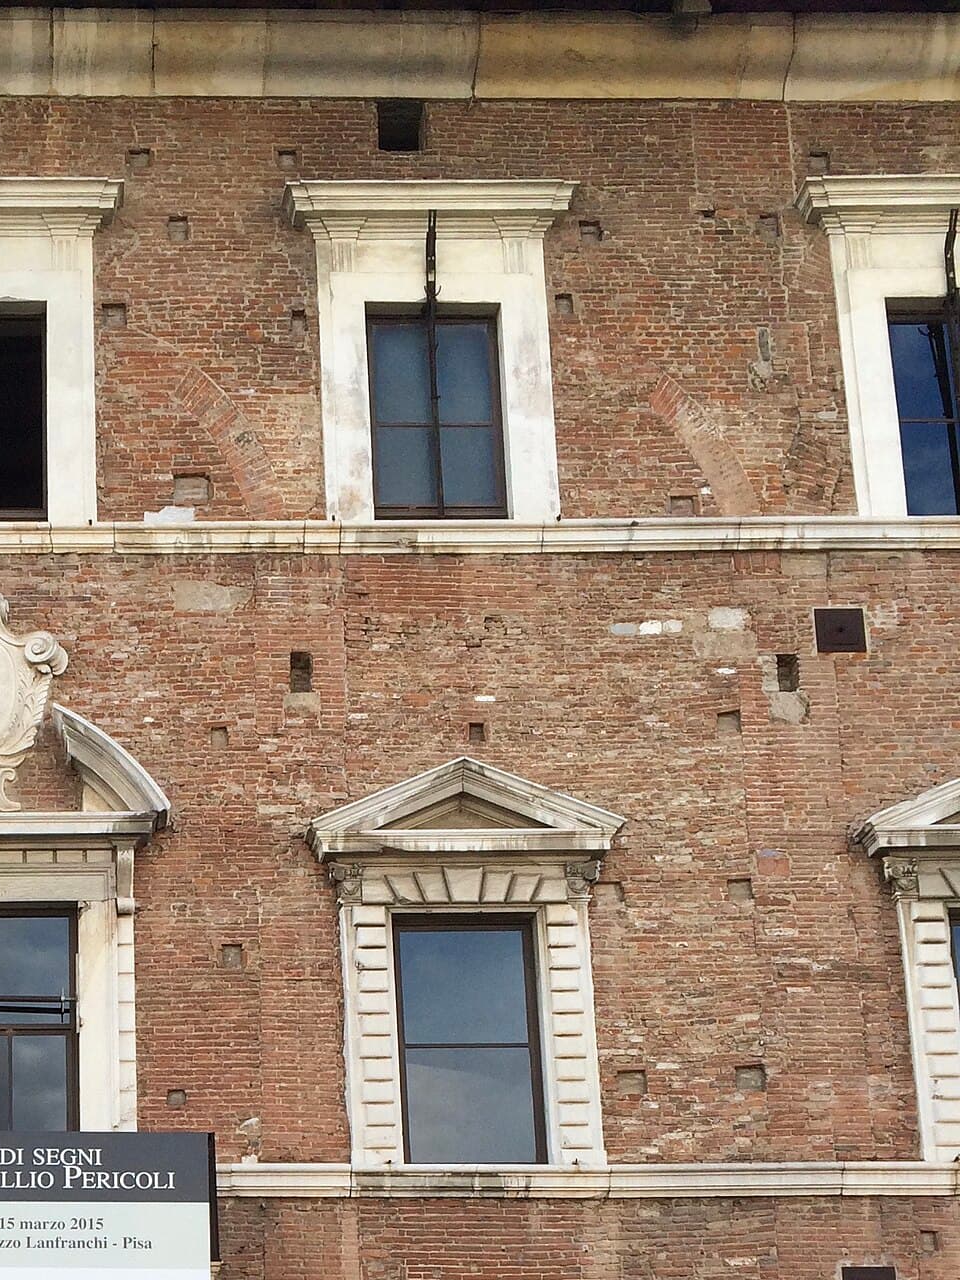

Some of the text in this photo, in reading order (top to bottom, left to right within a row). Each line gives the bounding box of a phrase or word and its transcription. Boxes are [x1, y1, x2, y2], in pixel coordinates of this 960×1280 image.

[0, 1148, 24, 1165] DI
[33, 1148, 102, 1166] SEGNI
[62, 1165, 176, 1189] PERICOLI
[0, 1217, 15, 1230] 15
[20, 1221, 66, 1230] marzo
[70, 1217, 104, 1230] 2015
[26, 1236, 108, 1249] Lanfranchi
[123, 1236, 152, 1249] Pisa
